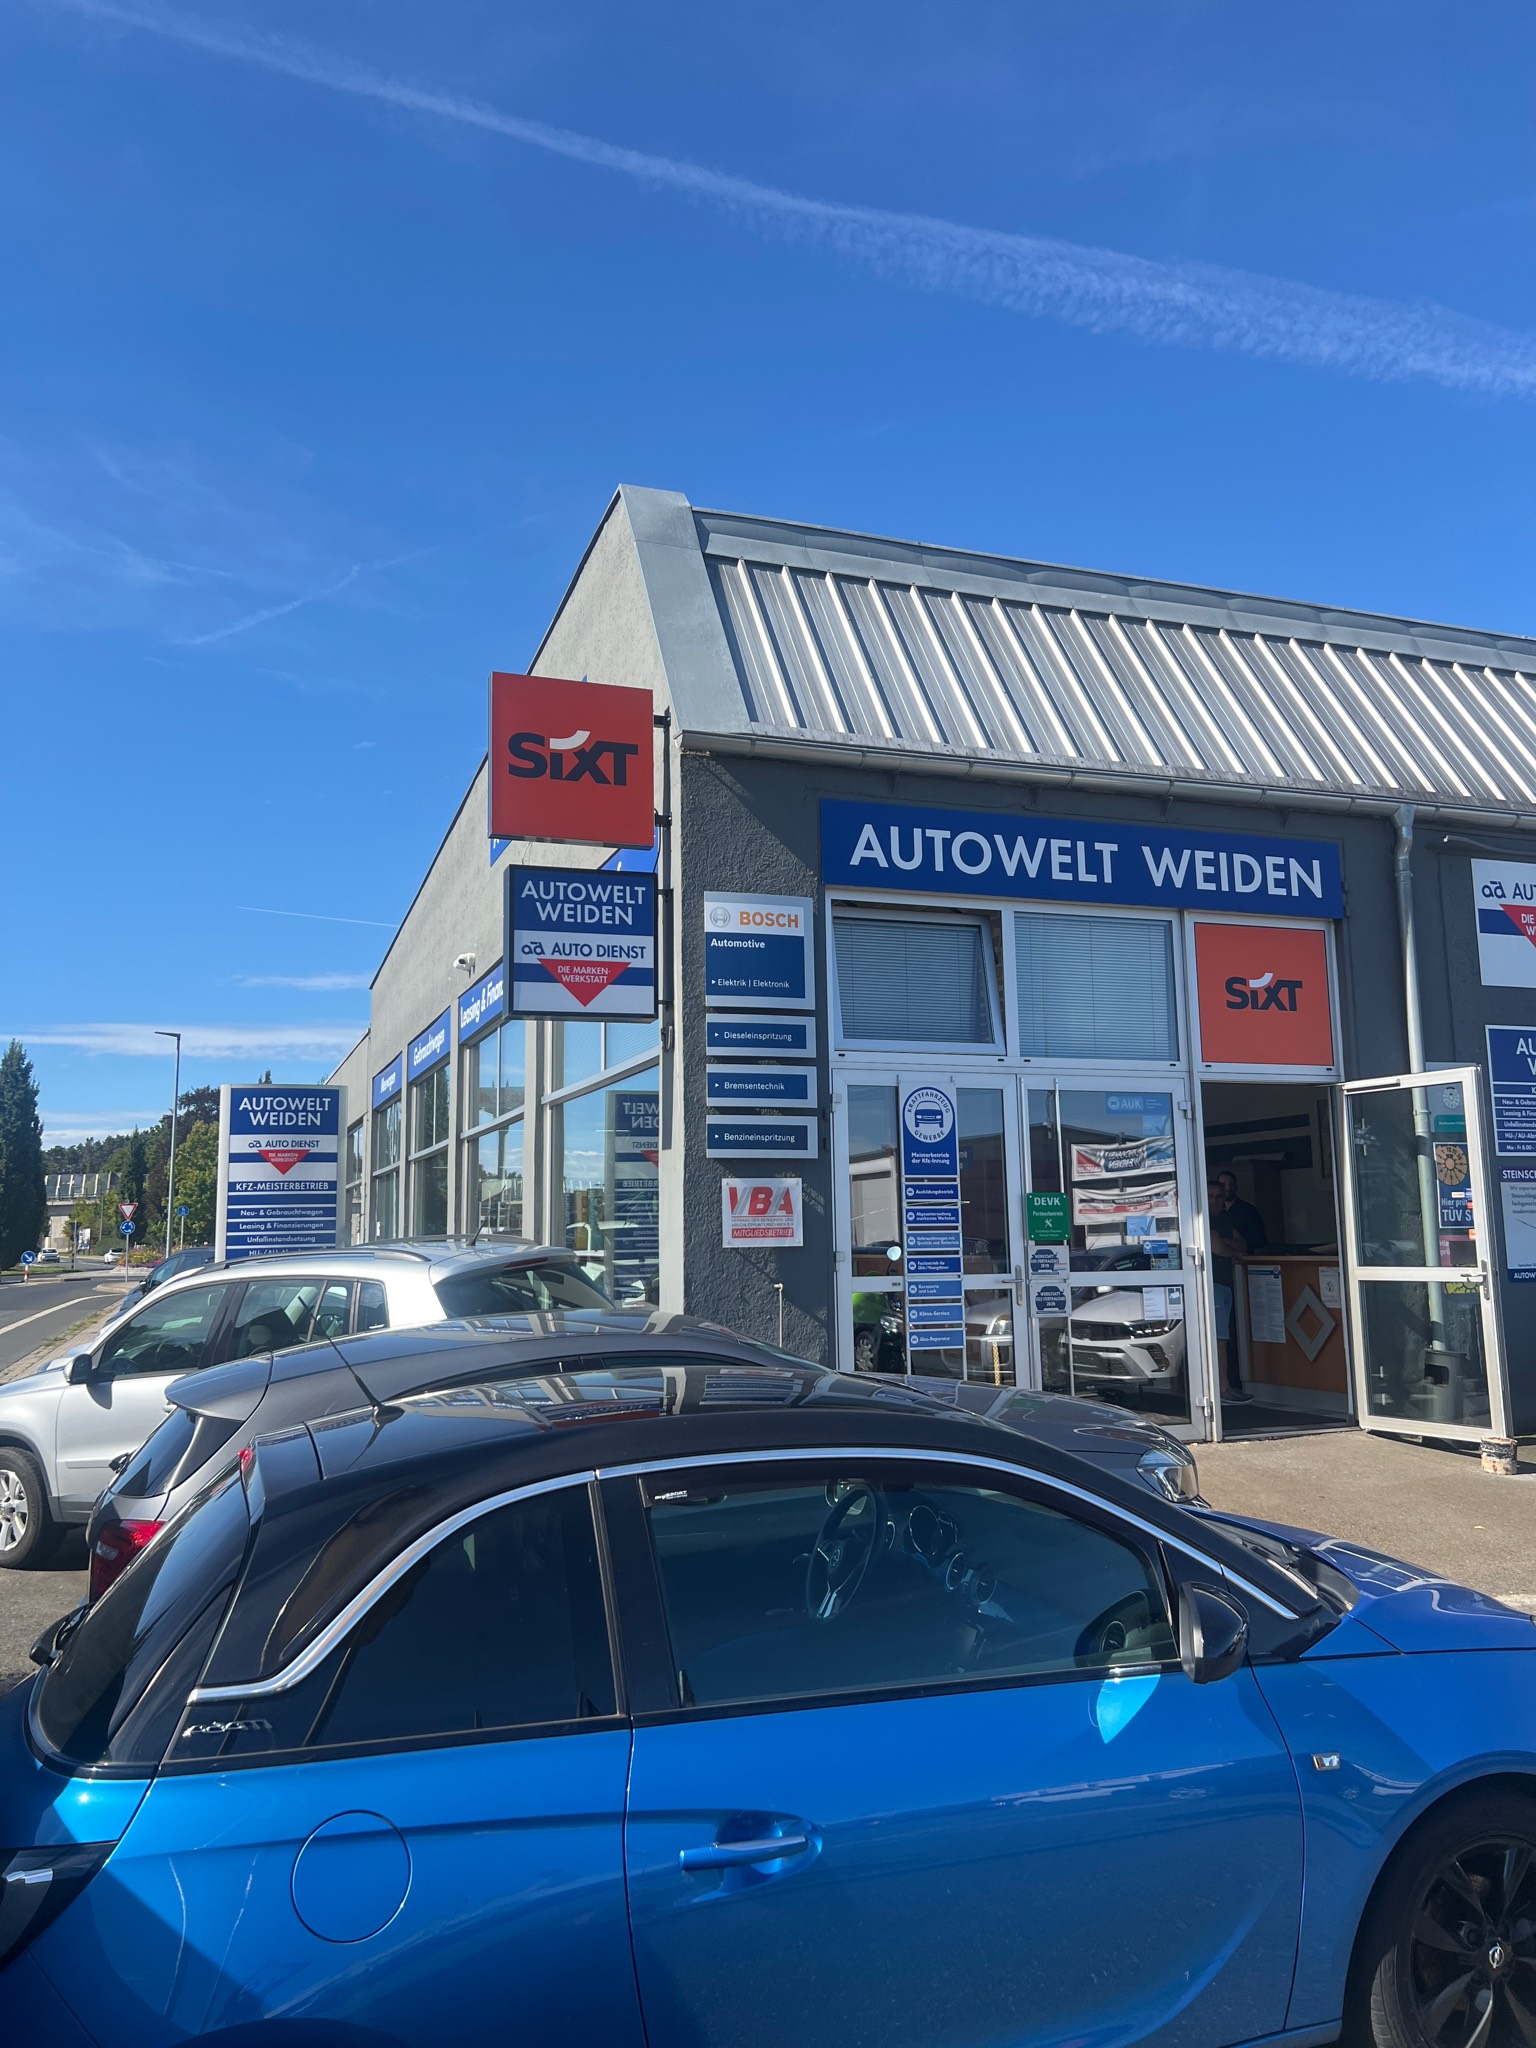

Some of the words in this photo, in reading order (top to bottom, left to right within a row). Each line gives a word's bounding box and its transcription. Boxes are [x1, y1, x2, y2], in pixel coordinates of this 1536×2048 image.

[849, 823, 1119, 884] AUTOWELT
[1141, 845, 1323, 899] WEIDEN
[521, 880, 646, 905] AUTOWELT
[535, 902, 633, 926] WEIDEN
[1521, 913, 1535, 924] DIE
[739, 911, 799, 929] BOSCH
[710, 938, 766, 949] Automotive
[551, 942, 593, 957] AUTO
[596, 944, 646, 960] DIENST
[557, 965, 571, 974] DIE
[572, 965, 612, 976] MARKEN-
[561, 974, 608, 984] WERKSTATT
[717, 978, 747, 987] Elektrik
[753, 979, 790, 989] Elektronik
[723, 1031, 793, 1042] Dieseleinspritzung
[723, 1081, 786, 1091] Bremsentechnik
[238, 1097, 331, 1111] AUTOWELT
[907, 1091, 951, 1114] KRAFTFAHRZEUG
[1121, 1099, 1142, 1109] AUK
[249, 1111, 321, 1126] WEIDEN
[723, 1132, 796, 1144] Benzineinspritzung
[914, 1129, 946, 1141] GEWERBE
[265, 1140, 289, 1148] AUTO
[291, 1140, 320, 1148] DIENST
[235, 1181, 329, 1191] KFZ-MEISTERBETRIEB
[728, 1186, 794, 1216] VBA
[1034, 1196, 1061, 1206] DEVK
[1440, 1198, 1454, 1206] Hier
[266, 1208, 324, 1217] Gebrauchtwagen
[1442, 1207, 1463, 1222] TÜV
[239, 1222, 265, 1231] Leasing
[273, 1221, 324, 1230] Finanzierungen
[732, 1228, 793, 1238] MITGLIEDSBETRIEB
[246, 1235, 316, 1243] Unfallinstandsetzung
